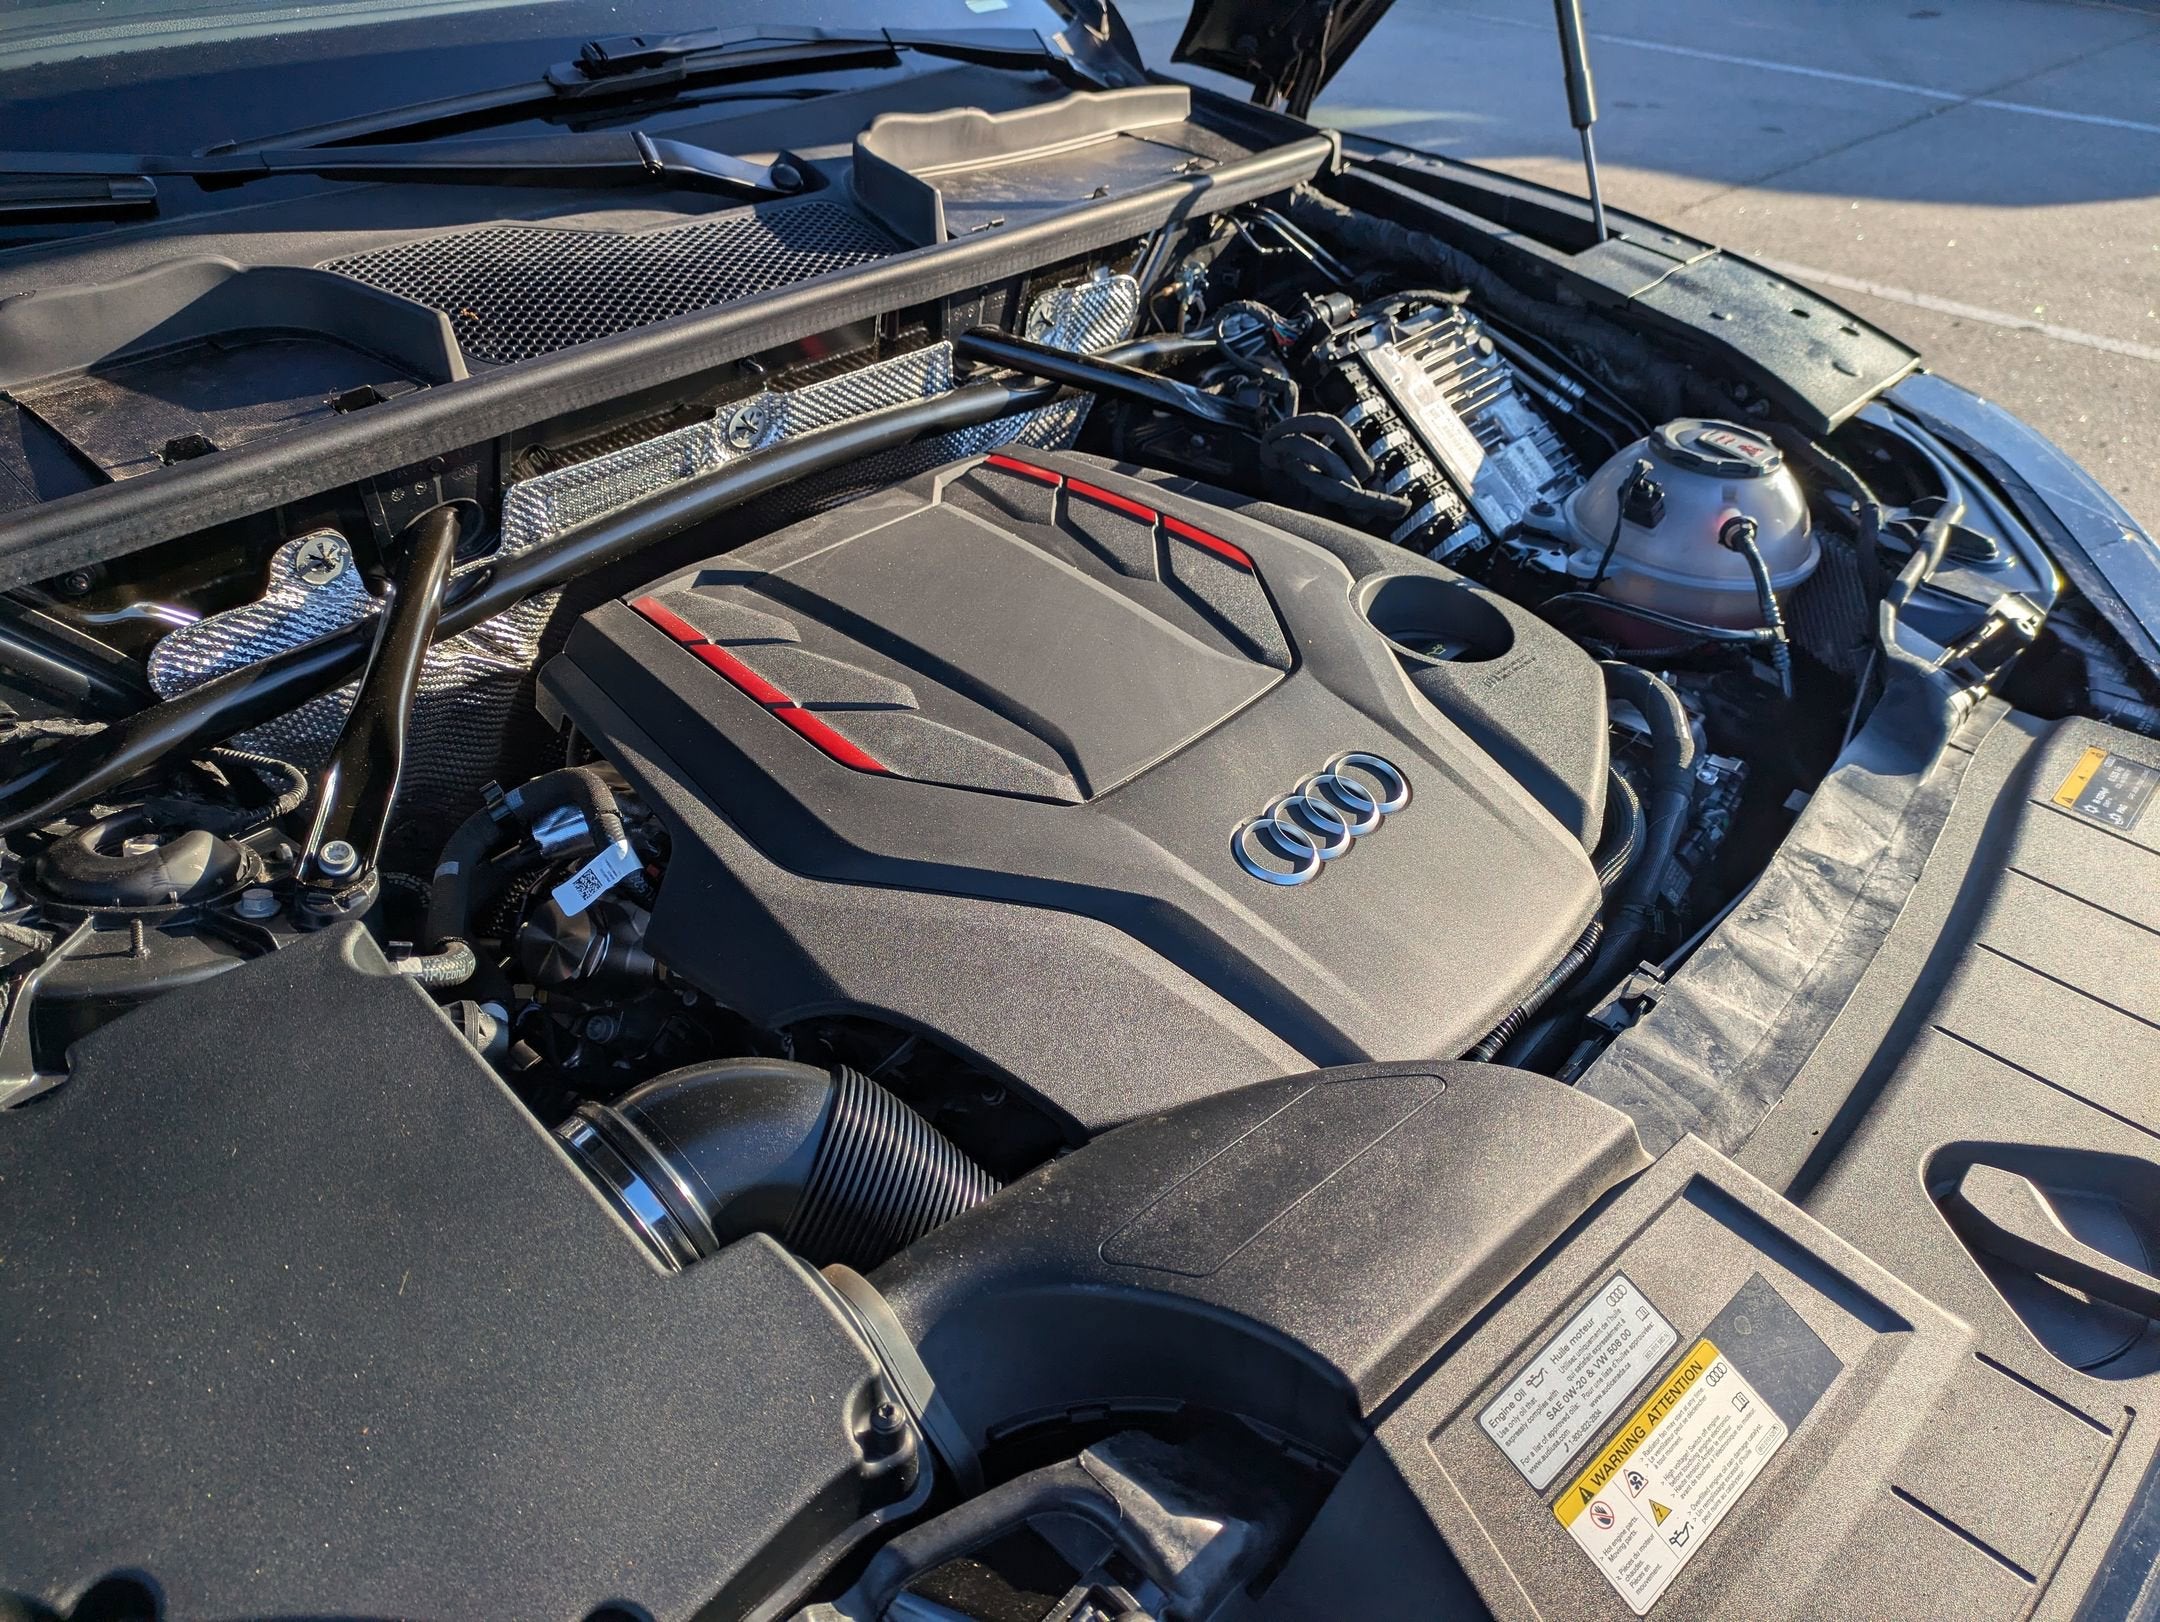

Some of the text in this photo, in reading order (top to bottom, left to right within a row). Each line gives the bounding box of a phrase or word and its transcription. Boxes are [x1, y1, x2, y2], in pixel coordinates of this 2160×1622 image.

[1549, 1317, 1595, 1365] Huile moteur
[1558, 1355, 1578, 1374] Utilisez
[1575, 1327, 1604, 1358] uniquement
[1546, 1400, 1565, 1421] SAE
[1562, 1375, 1588, 1404] 0W-20
[1592, 1352, 1609, 1369] VW
[1606, 1338, 1623, 1356] 508
[1580, 1386, 1595, 1401] Pour
[1589, 1362, 1632, 1408] www.audicanada.ca
[1488, 1401, 1516, 1429] Engine
[1505, 1421, 1529, 1447] expressly
[1526, 1400, 1549, 1424] complies
[1508, 1414, 1521, 1429] only
[1547, 1411, 1571, 1439] approved
[1590, 1360, 1703, 1487] WARNING ATTENTION
[1527, 1429, 1571, 1475] www.audiusa.com
[1641, 1437, 1661, 1458] Radiator
[1654, 1432, 1675, 1457] ventilateur
[1673, 1449, 1690, 1470] voltage!
[1687, 1436, 1703, 1453] Switch
[1673, 1478, 1688, 1494] Haute
[1685, 1459, 1703, 1480] tension!
[1717, 1424, 1732, 1442] moteur
[1668, 1470, 1684, 1488] before
[1680, 1451, 1701, 1473] touching
[1698, 1437, 1713, 1454] engine
[1690, 1486, 1711, 1511] Overfilled
[1709, 1472, 1723, 1490] engine
[1733, 1440, 1750, 1460] damage
[1680, 1484, 1693, 1500] avant
[1695, 1461, 1712, 1481] toucher
[1702, 1481, 1726, 1510] remplissage
[1611, 1529, 1628, 1547] engine
[1625, 1516, 1639, 1532] parts.
[1701, 1510, 1713, 1525] peut
[1607, 1529, 1638, 1563] Moving parts.
[1638, 1533, 1655, 1553] moteur
